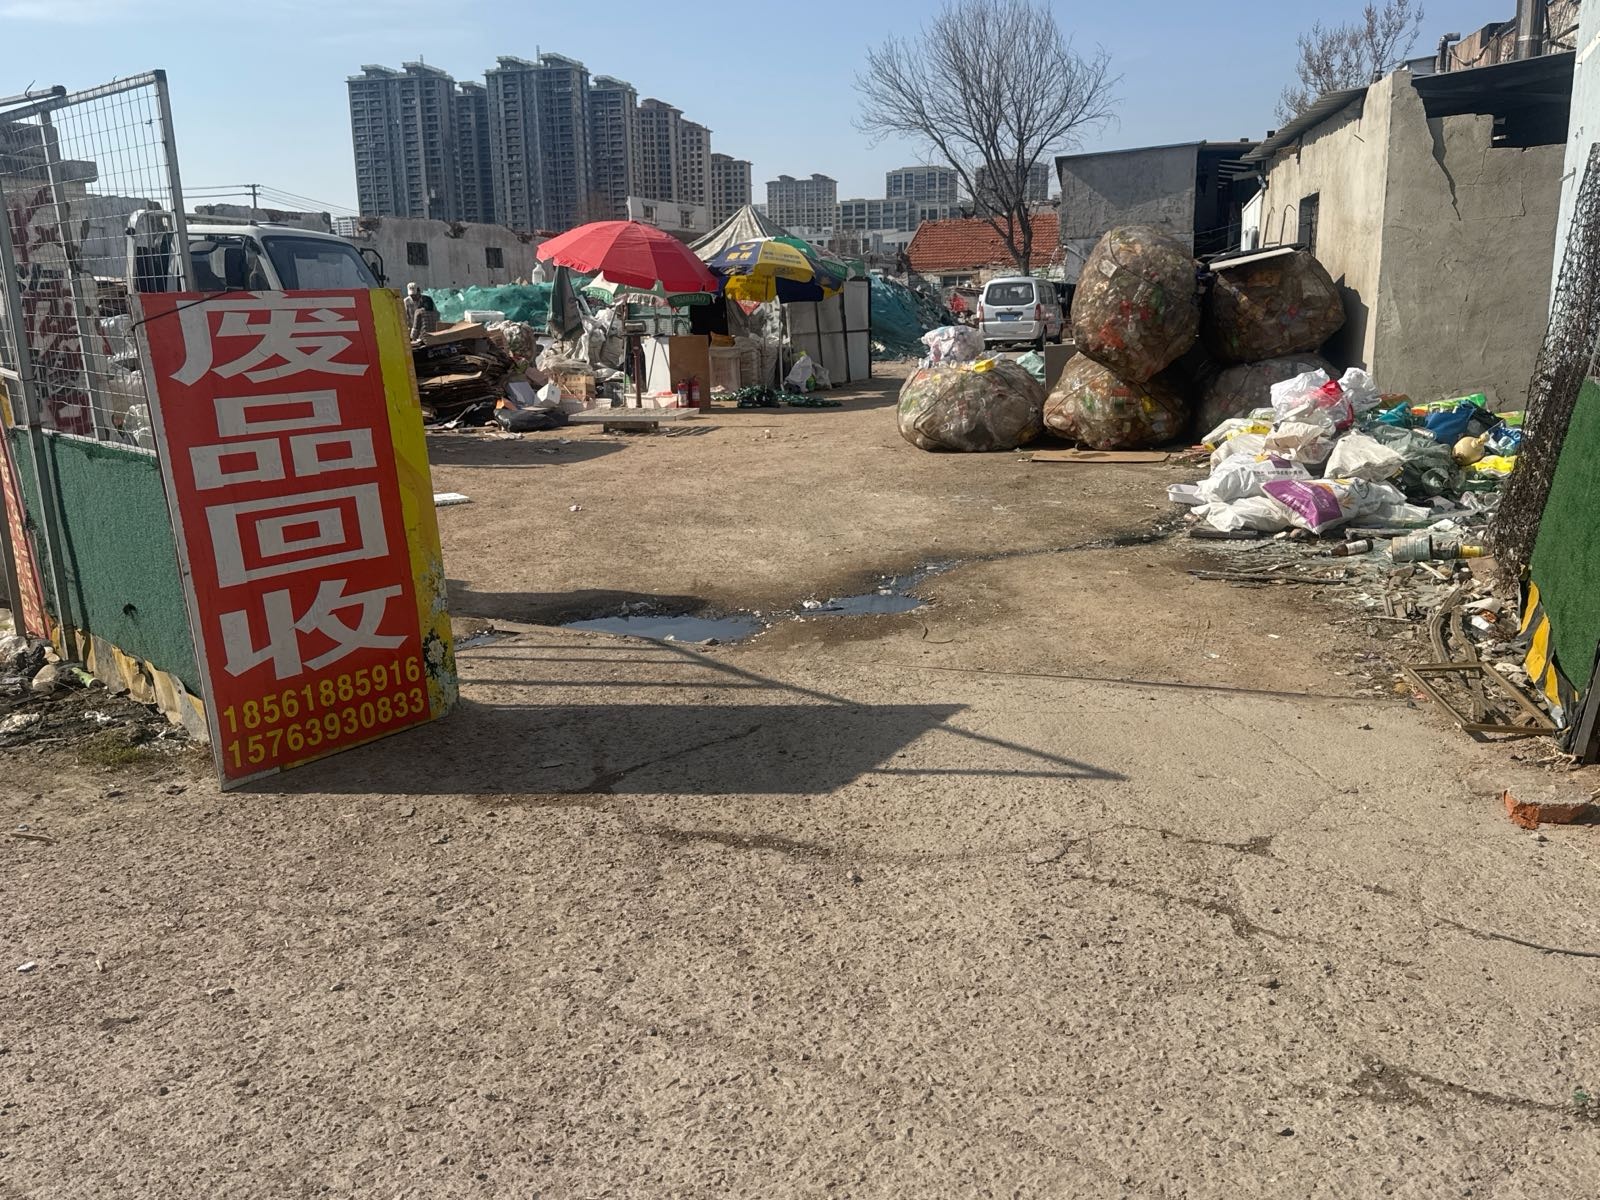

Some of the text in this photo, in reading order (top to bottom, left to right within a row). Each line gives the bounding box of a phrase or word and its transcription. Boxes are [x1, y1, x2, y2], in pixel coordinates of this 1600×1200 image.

[170, 290, 408, 680] 废品回收
[223, 656, 420, 733] 18561885916
[228, 688, 424, 768] 15763930833
